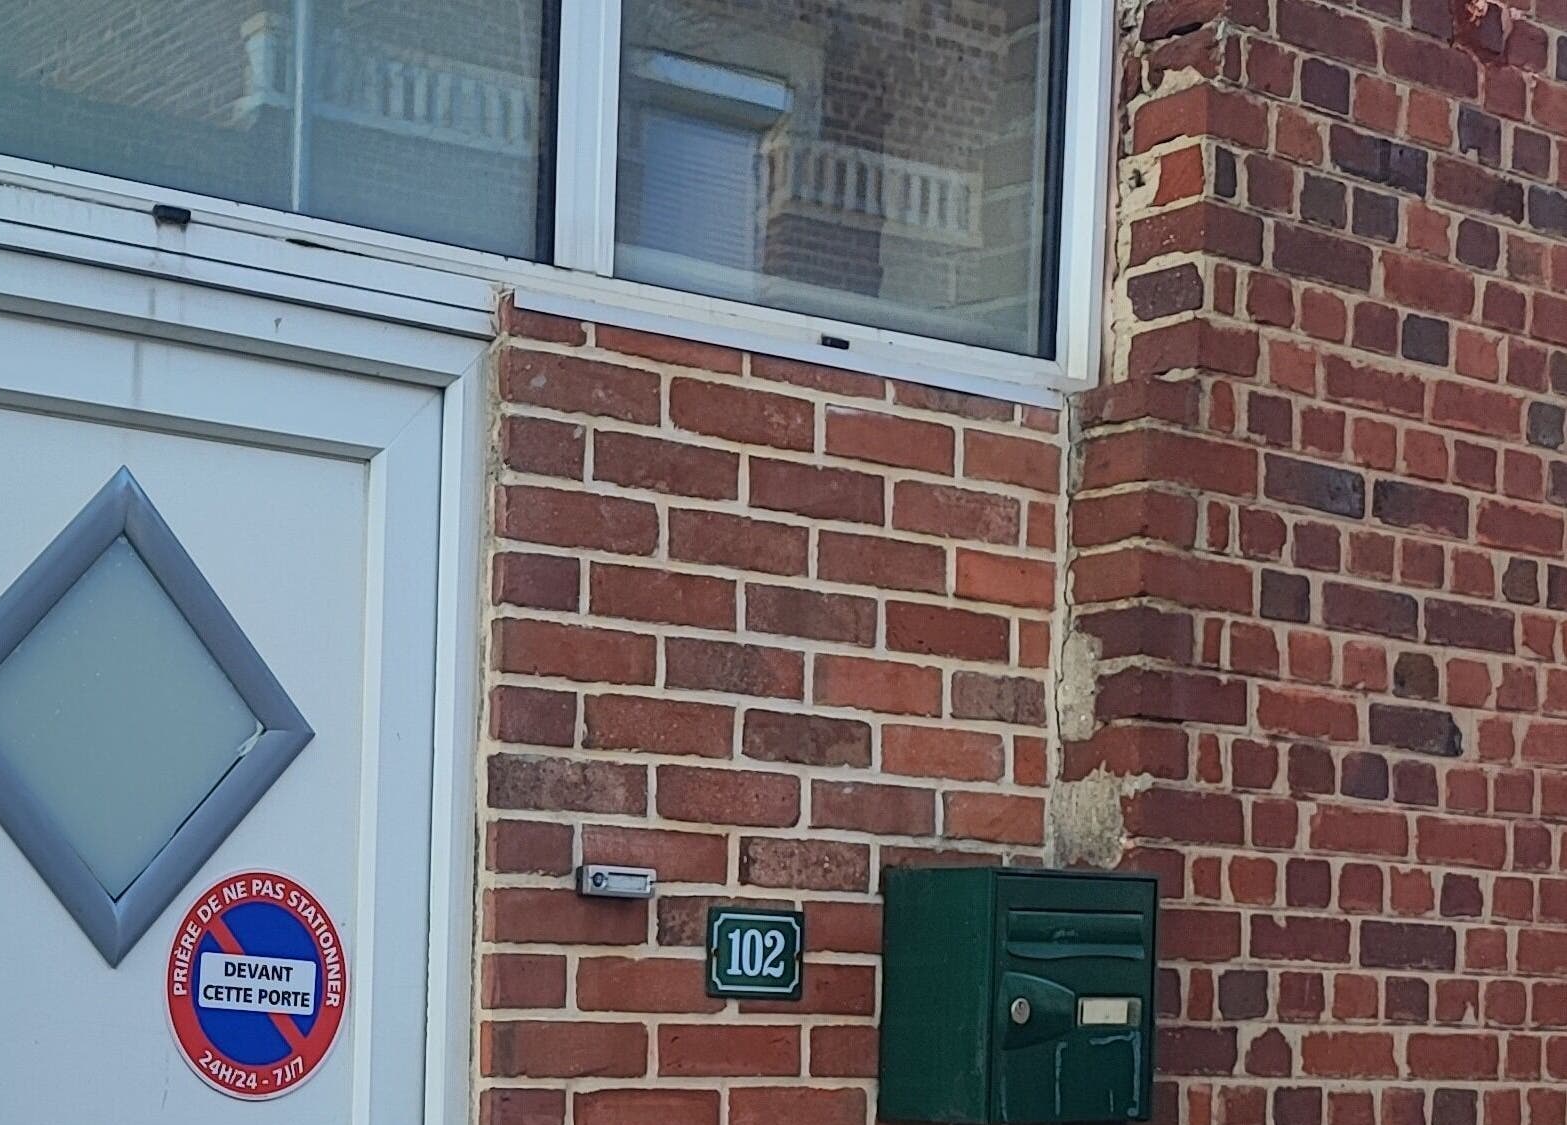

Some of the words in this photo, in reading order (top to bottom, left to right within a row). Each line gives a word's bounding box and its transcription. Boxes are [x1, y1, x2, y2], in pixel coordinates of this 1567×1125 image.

[173, 920, 202, 996] PRIÈRE
[197, 894, 222, 924] DE
[222, 880, 248, 901] NE
[251, 879, 286, 900] PAS
[286, 890, 343, 1008] STATIONNER
[726, 928, 786, 978] 102
[223, 961, 294, 983] DEVANT
[202, 984, 253, 1005] CETTE
[257, 988, 311, 1008] PORTE
[198, 1050, 258, 1090] 24H/24
[272, 1056, 304, 1086] 7J/7
